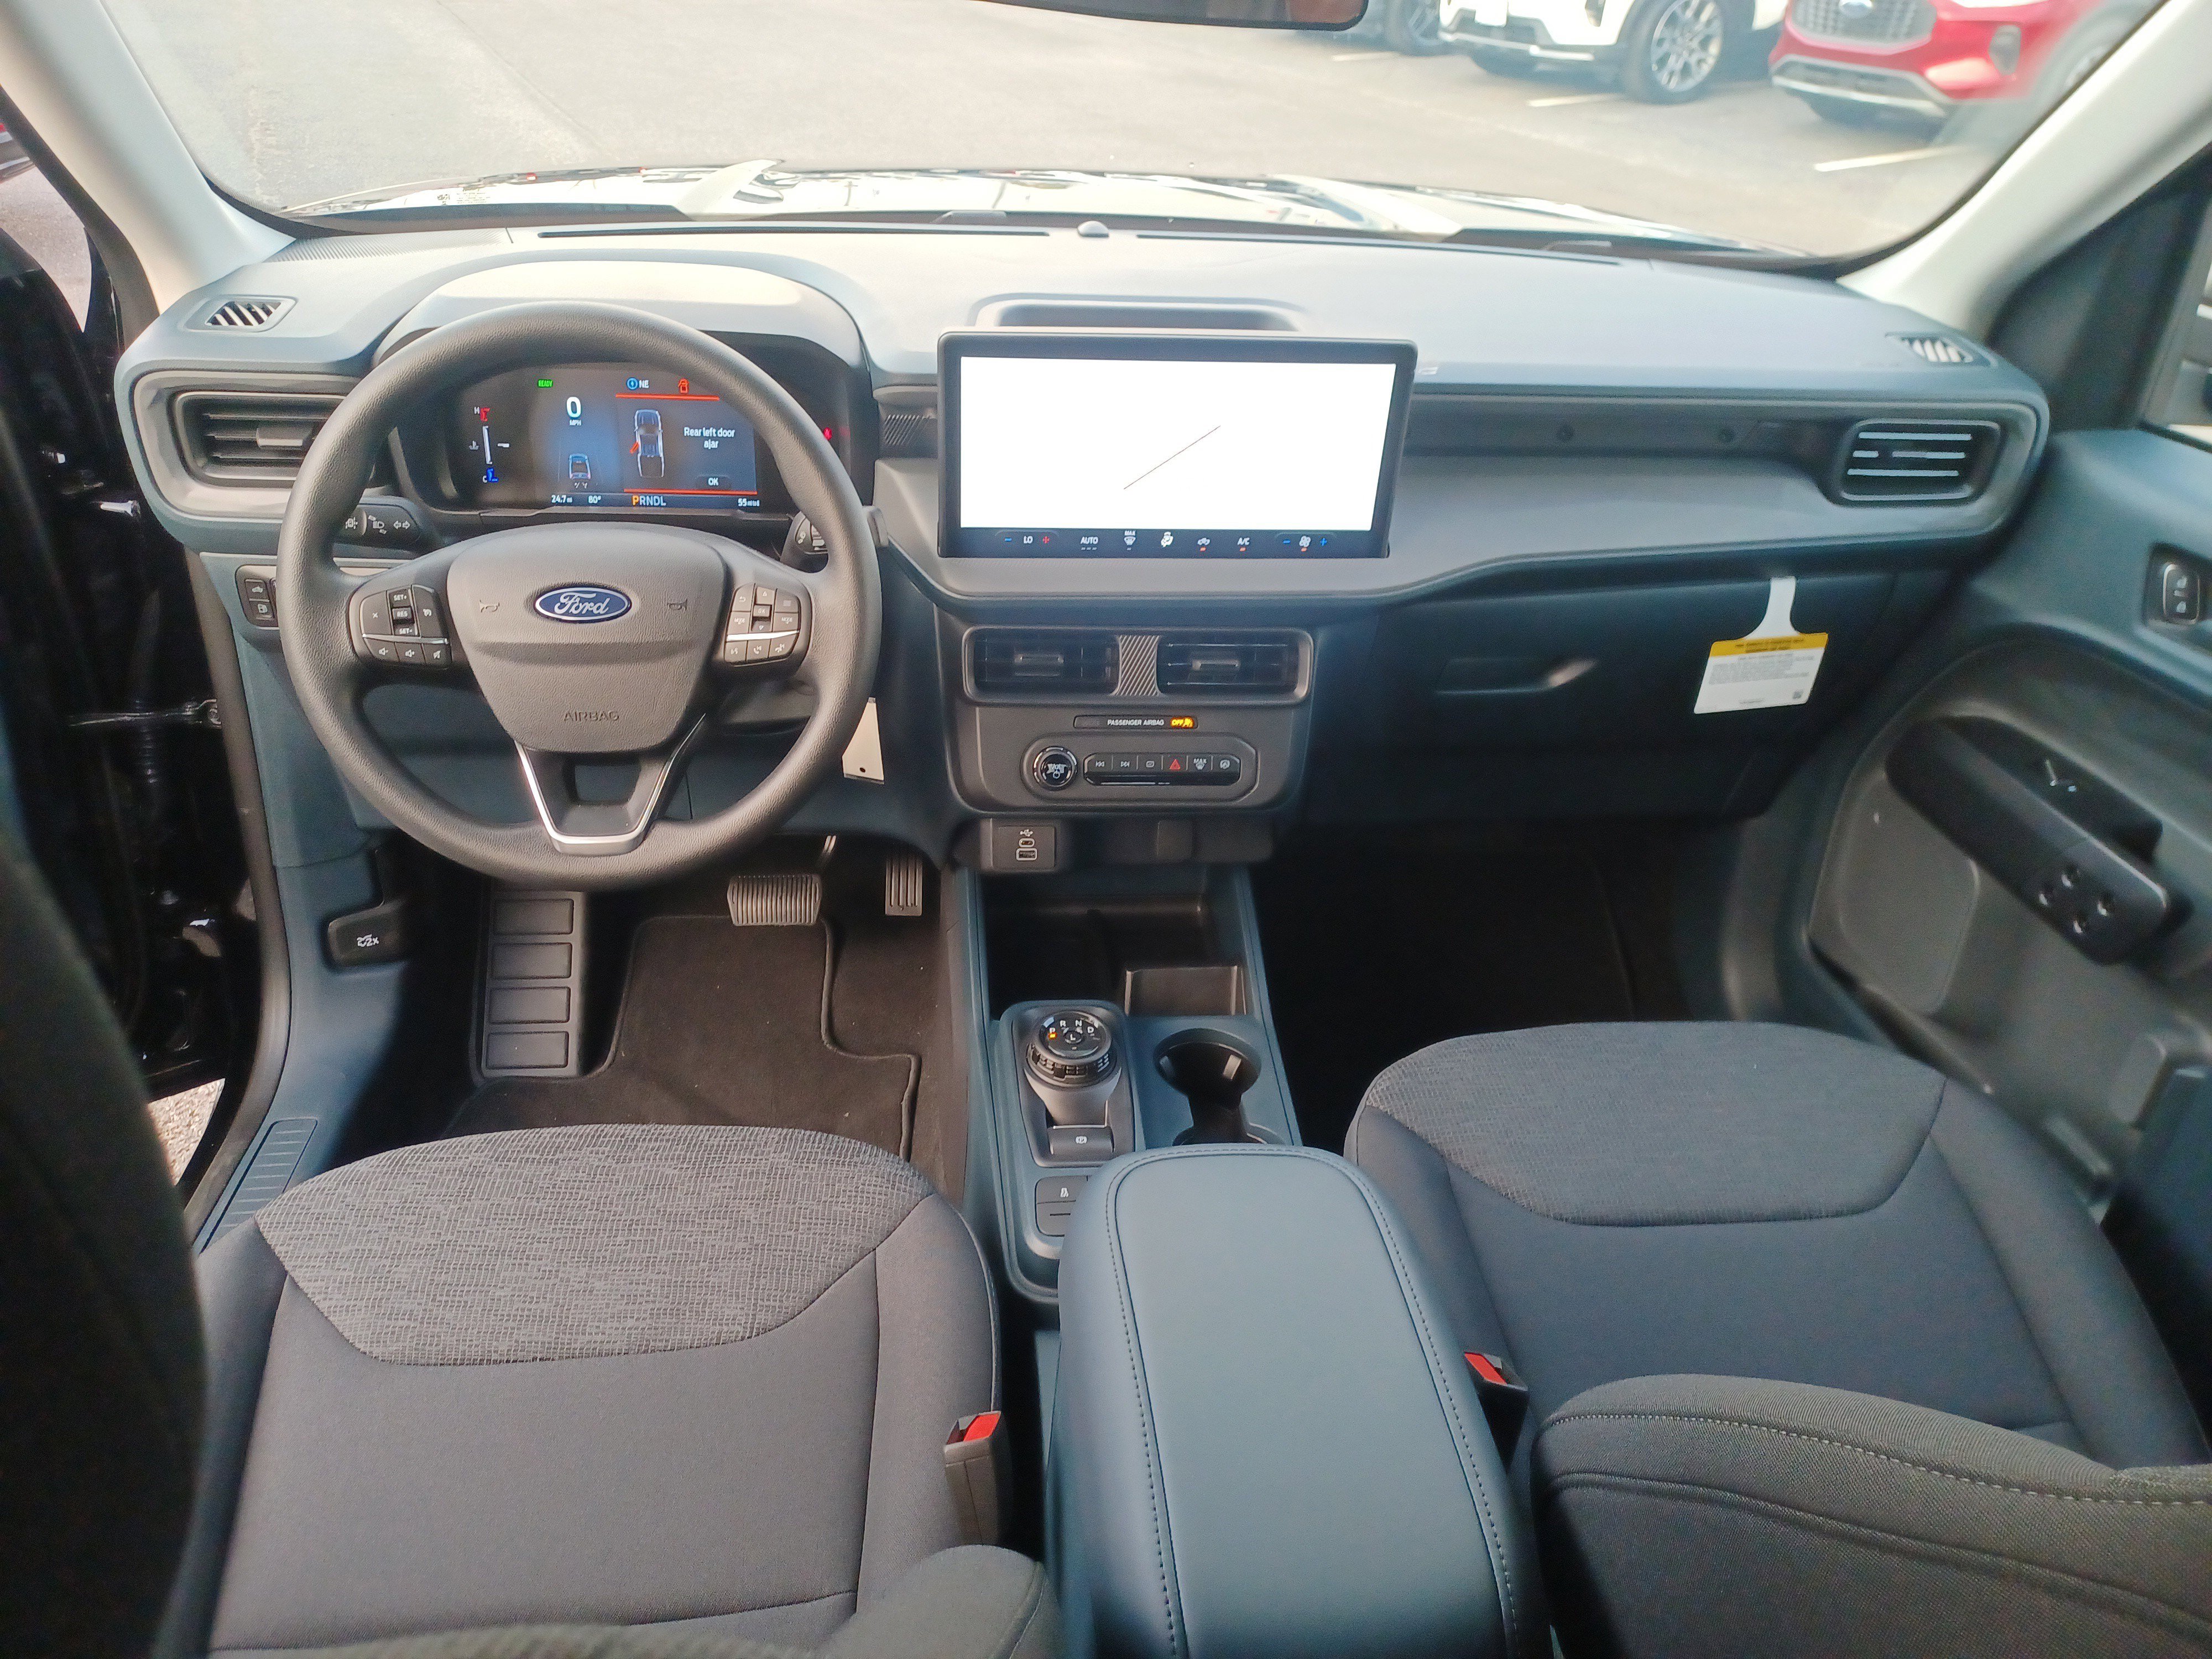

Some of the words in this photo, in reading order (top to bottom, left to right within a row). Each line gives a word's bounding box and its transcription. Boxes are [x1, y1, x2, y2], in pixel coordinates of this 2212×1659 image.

[639, 380, 649, 388] NE
[566, 397, 581, 418] 0
[684, 427, 702, 436] Rear
[702, 427, 716, 436] left
[717, 427, 735, 437] door
[703, 439, 719, 449] ajar
[708, 477, 719, 486] OK
[551, 494, 566, 503] 24.7
[1023, 535, 1034, 544] LO
[1080, 536, 1099, 545] AUTO
[1237, 537, 1250, 545] A/C
[554, 592, 611, 614] Ford
[564, 710, 619, 722] AIRBAG
